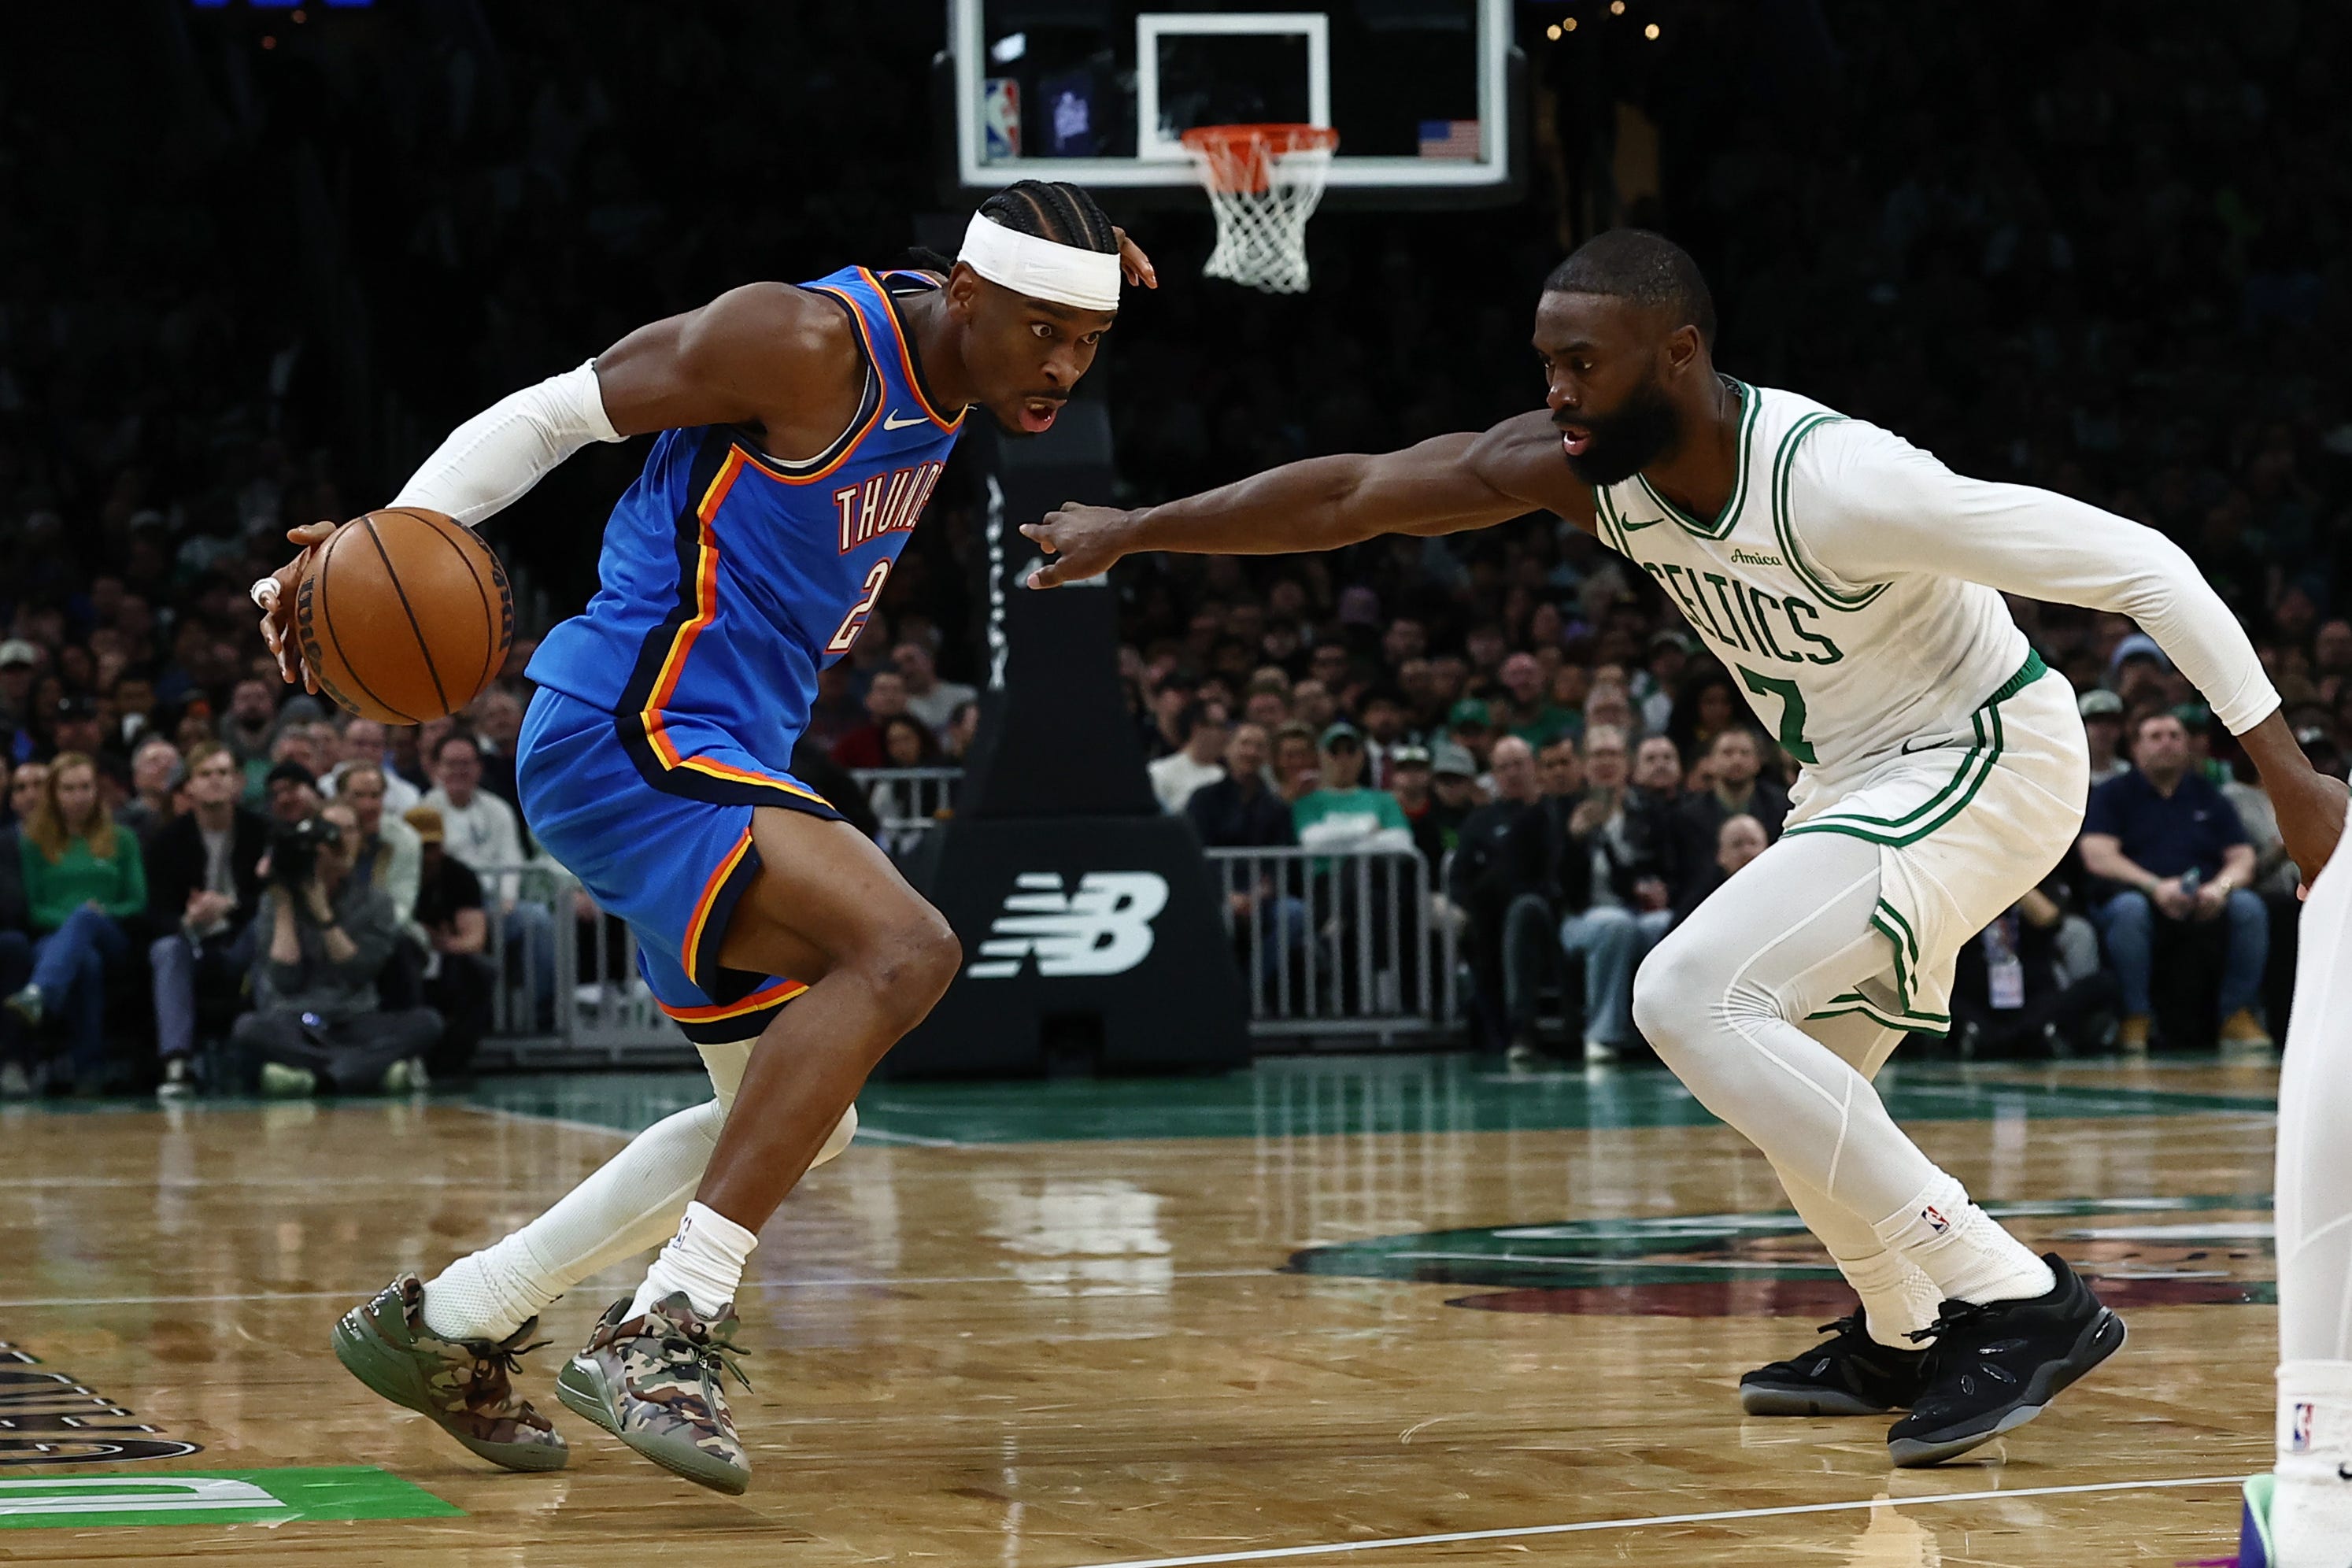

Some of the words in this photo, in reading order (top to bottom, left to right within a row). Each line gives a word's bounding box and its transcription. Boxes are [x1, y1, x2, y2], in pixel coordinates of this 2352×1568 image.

[834, 460, 945, 555] THUND
[1730, 548, 1783, 566] Amica
[1735, 661, 1819, 764] 7
